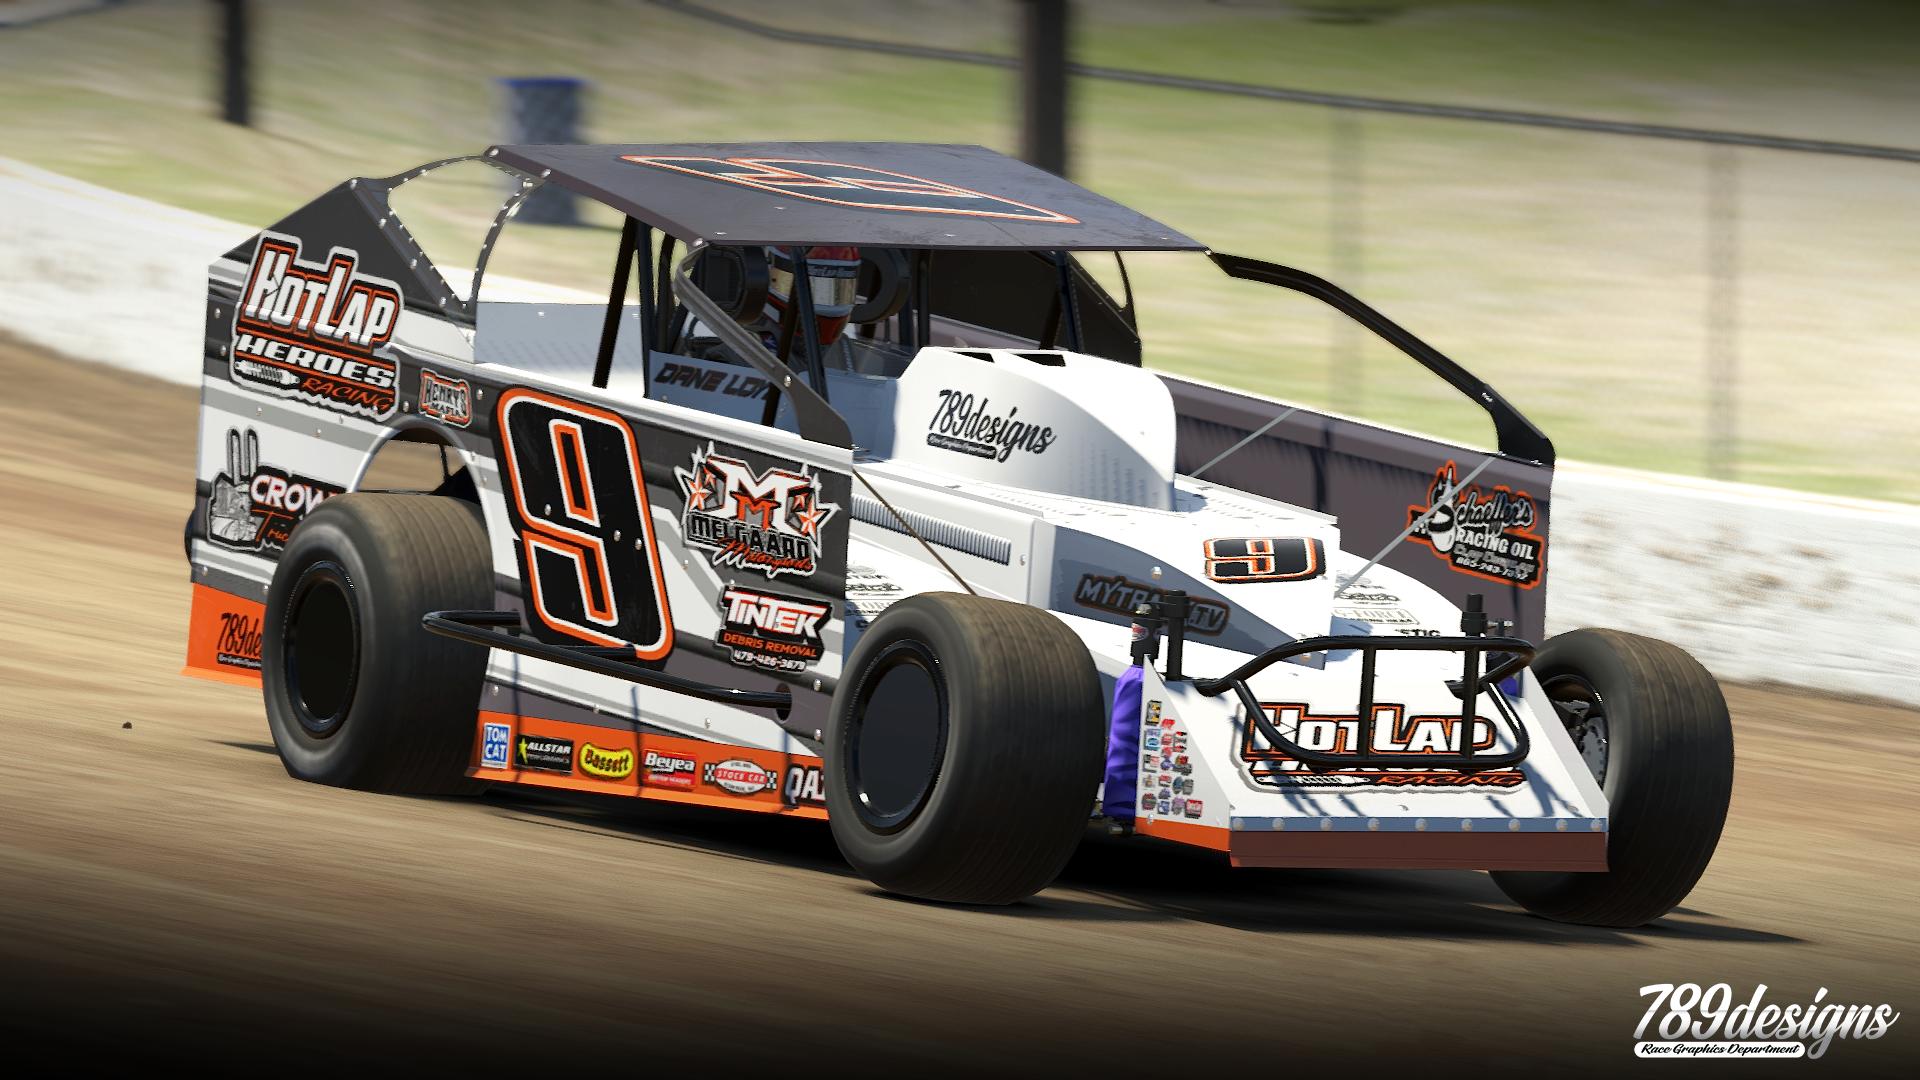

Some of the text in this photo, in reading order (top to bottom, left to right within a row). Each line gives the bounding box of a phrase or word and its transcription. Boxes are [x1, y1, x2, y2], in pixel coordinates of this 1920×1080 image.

[244, 249, 396, 346] HOTLAP
[234, 333, 395, 388] HEROES
[301, 377, 393, 411] RACING
[928, 389, 1057, 463] 789designs
[498, 387, 675, 662] 9
[1204, 536, 1327, 584] 9
[1455, 527, 1535, 560] RACING OIL
[724, 590, 828, 639] TINTEK
[1079, 577, 1226, 631] MYTR.TV
[722, 633, 818, 658] DEBRIS REMOVAL
[484, 743, 507, 760] CAT
[486, 726, 508, 743] TOM
[527, 741, 571, 755] ALLSTAR
[585, 748, 630, 773] Bassett
[645, 752, 696, 773] Beyea
